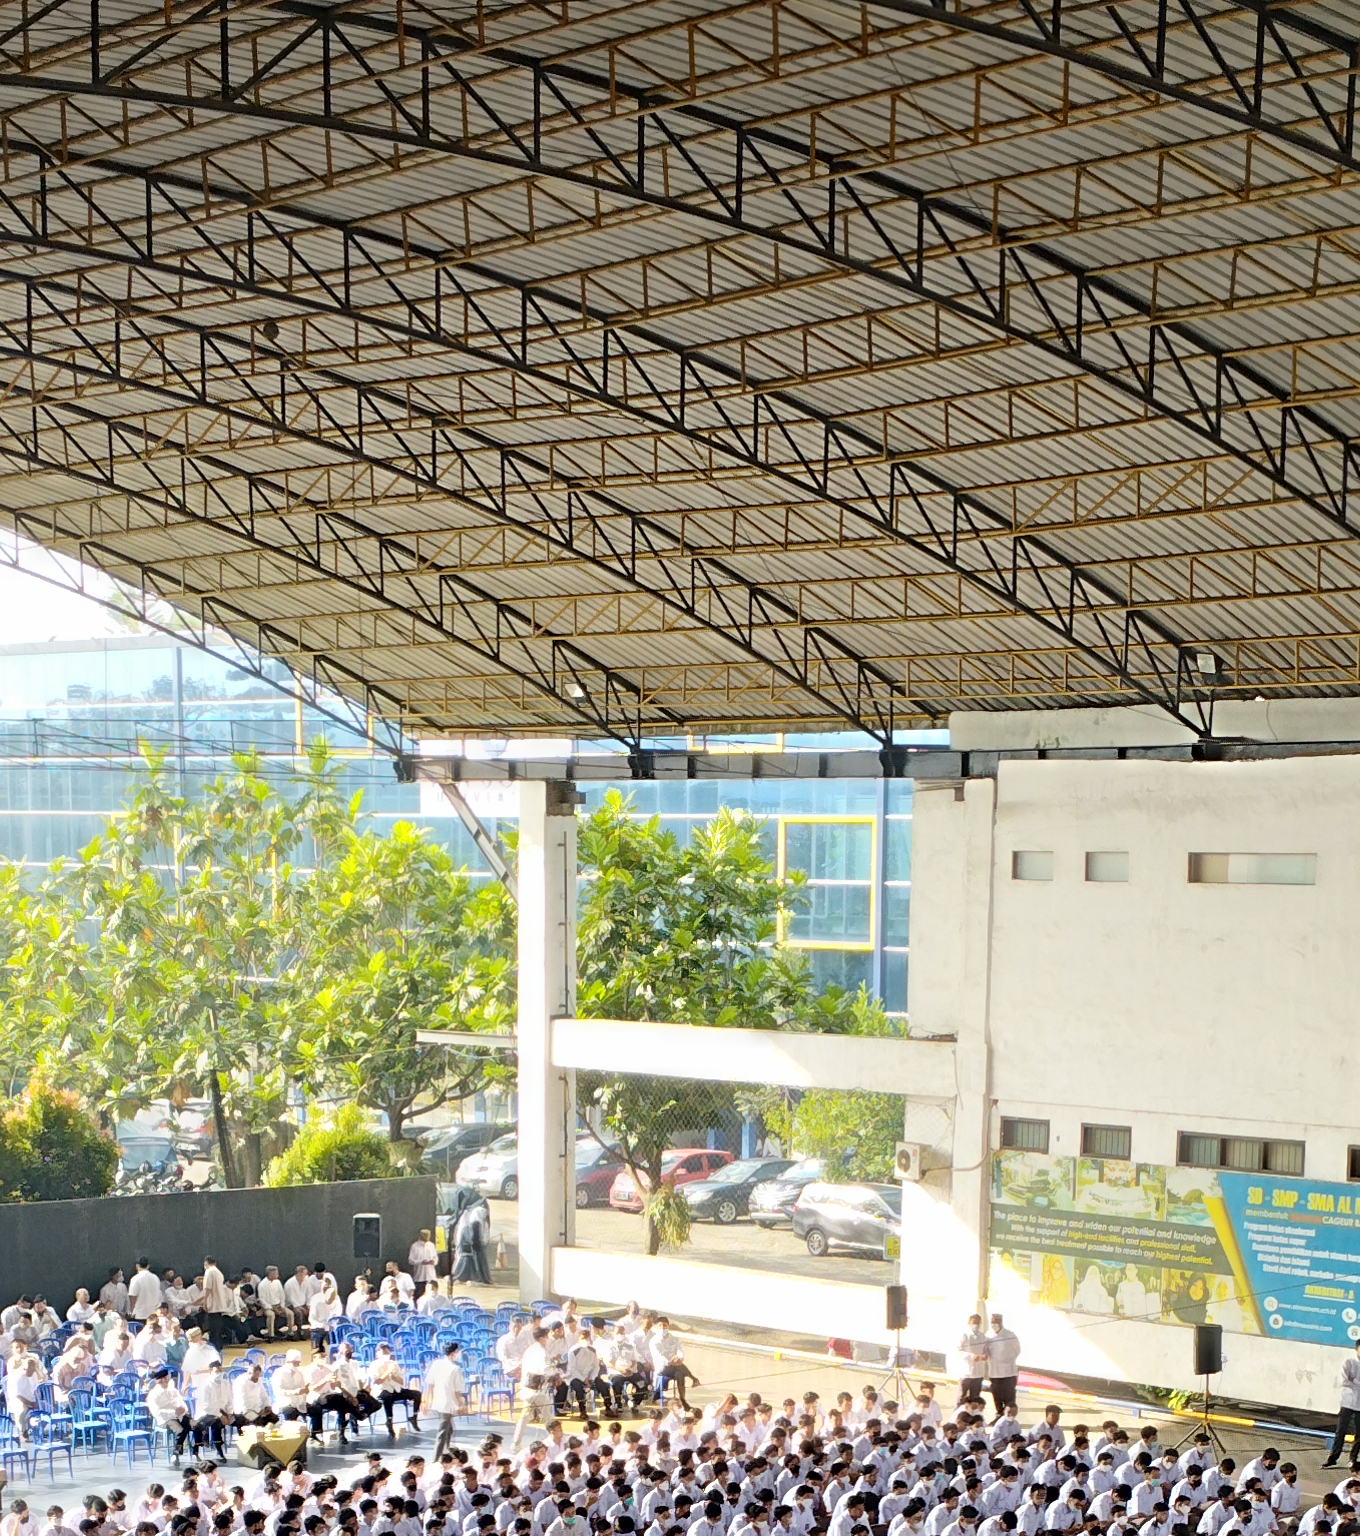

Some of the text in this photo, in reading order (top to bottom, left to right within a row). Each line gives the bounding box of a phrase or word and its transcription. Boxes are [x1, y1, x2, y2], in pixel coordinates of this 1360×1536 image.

[1247, 1187, 1263, 1205] SD
[1272, 1189, 1298, 1208] SMP
[1307, 1193, 1335, 1212] SMA
[1337, 1196, 1351, 1214] AL
[993, 1210, 1217, 1246] The place to improve and widen our potential and knowledge
[1322, 1215, 1353, 1227] CAGEUR
[1030, 1235, 1041, 1244] the
[1041, 1236, 1055, 1246] best
[1088, 1242, 1115, 1254] possible
[1115, 1245, 1122, 1253] to
[1122, 1246, 1143, 1257] reach
[1036, 1227, 1060, 1238] support
[1125, 1236, 1140, 1246] and
